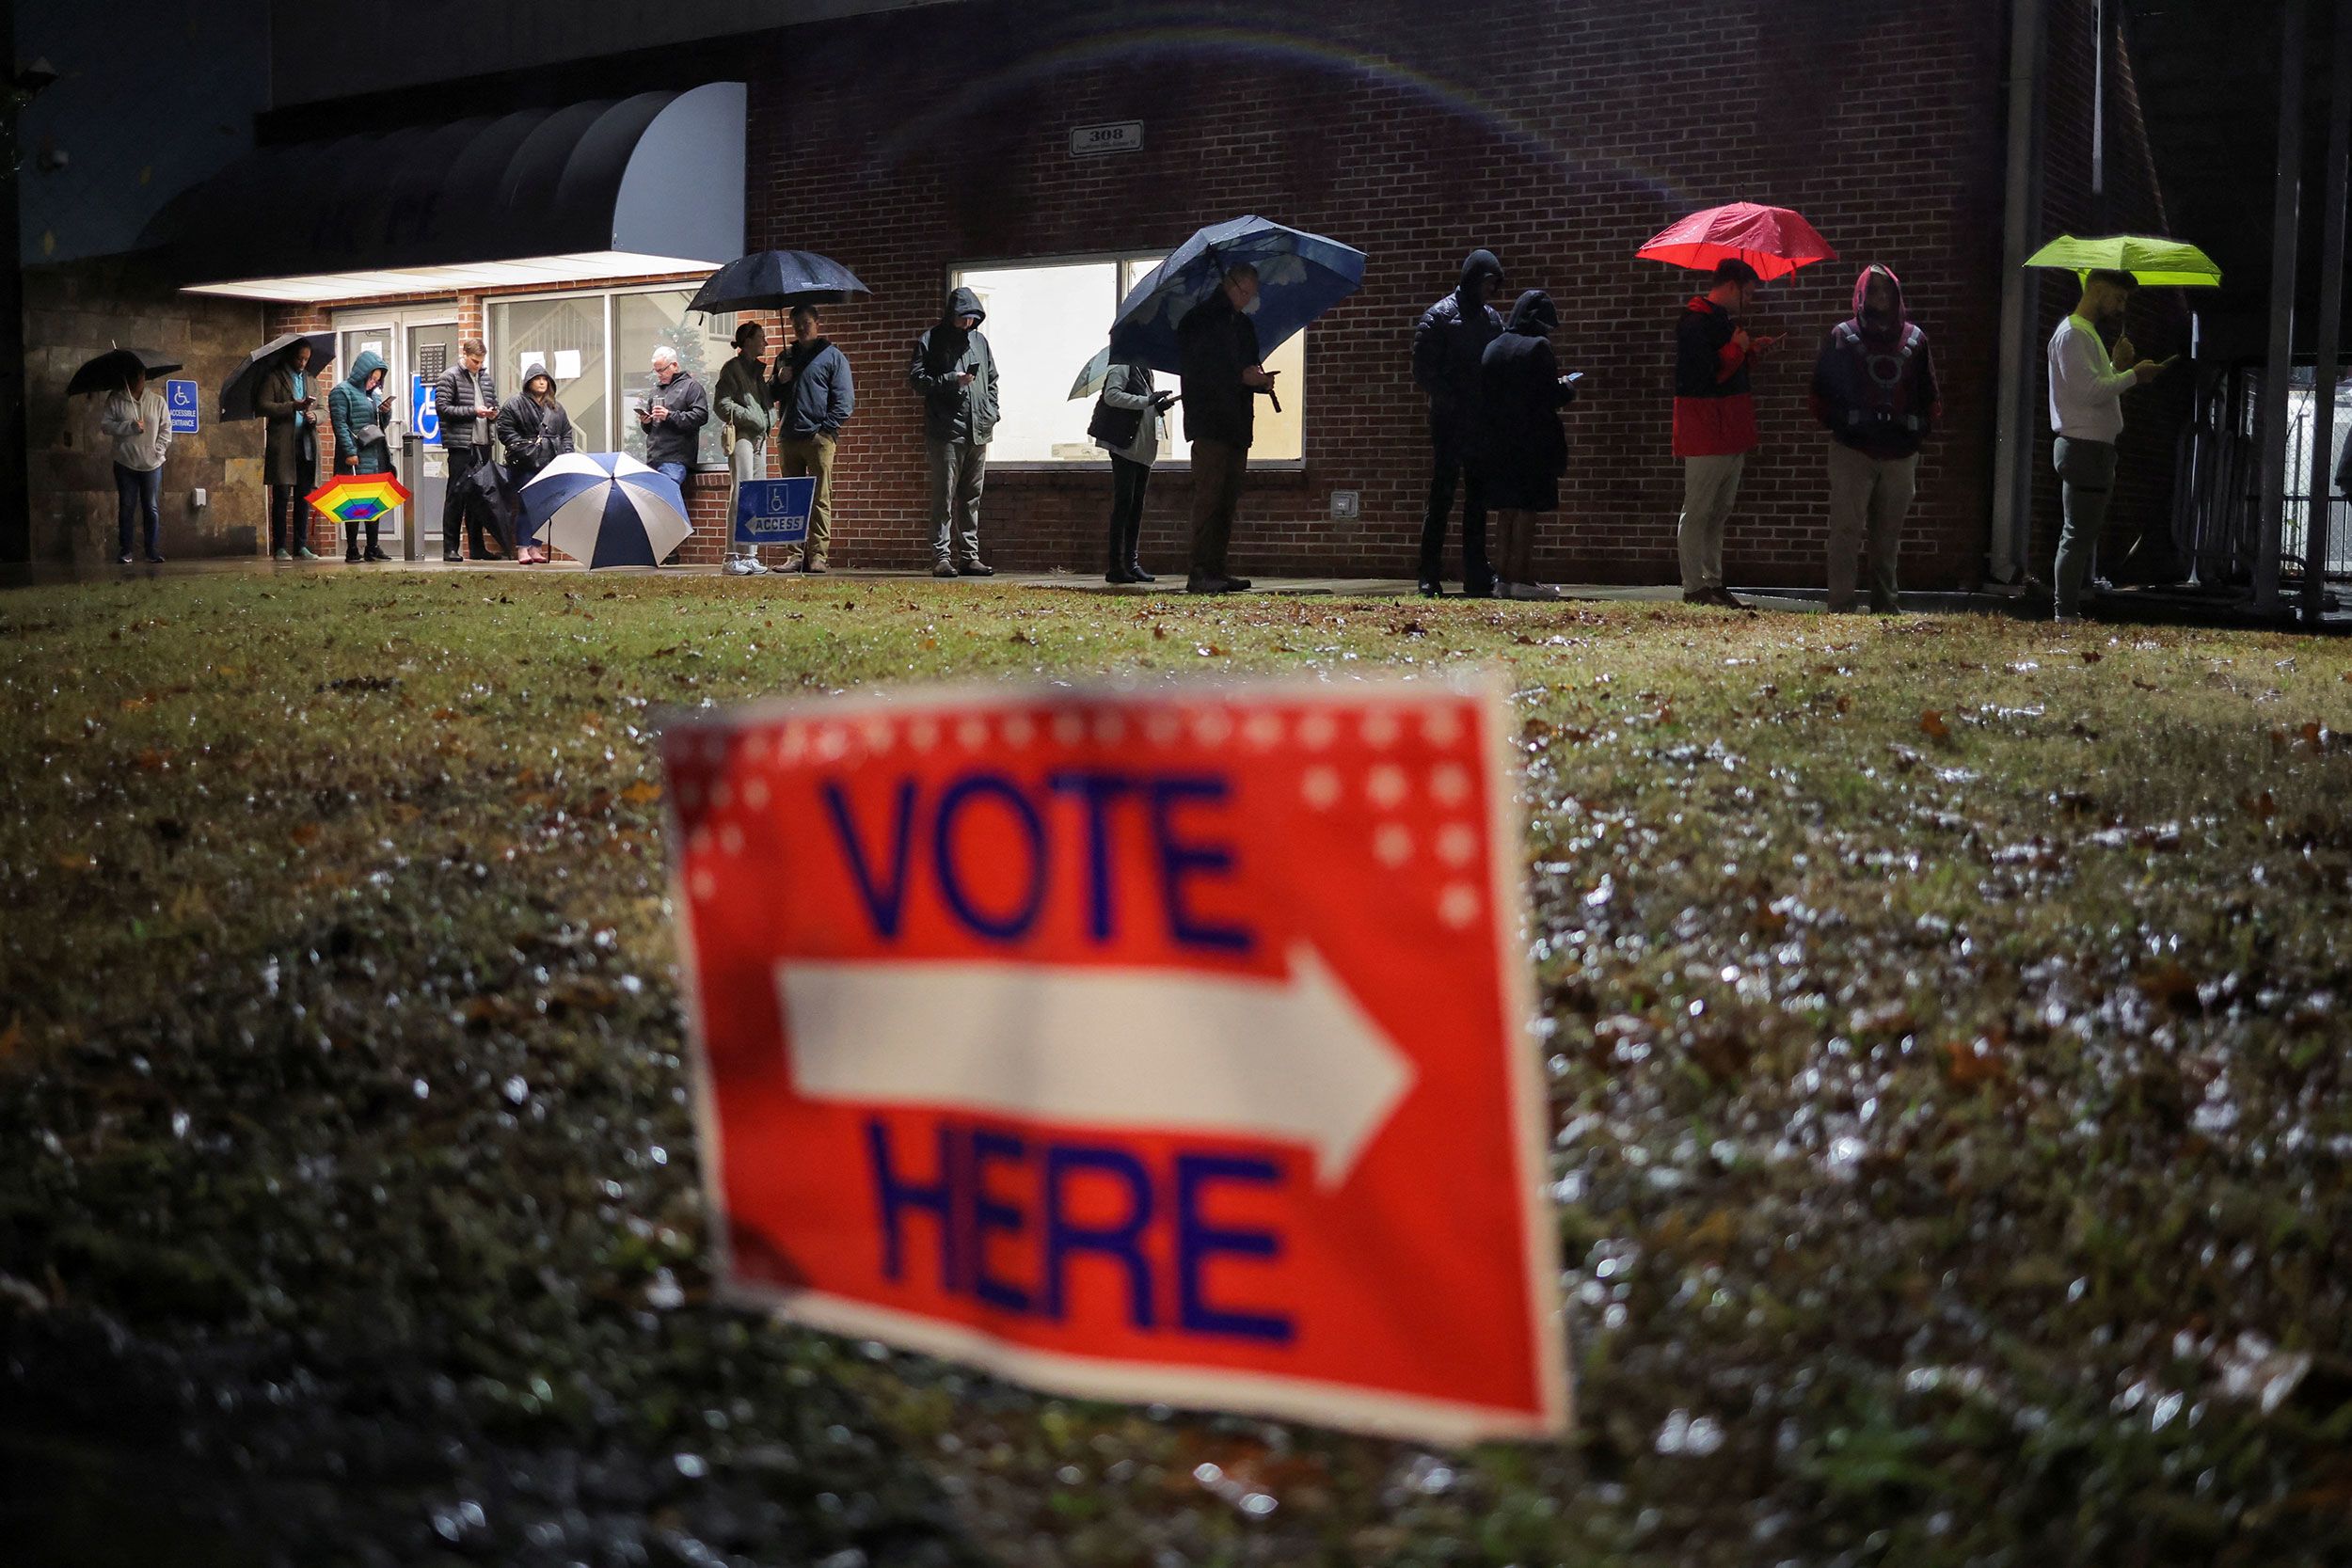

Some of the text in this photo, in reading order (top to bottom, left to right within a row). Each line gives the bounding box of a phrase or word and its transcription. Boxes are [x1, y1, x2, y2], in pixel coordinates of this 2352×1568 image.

[1089, 129, 1123, 141] 308
[755, 517, 801, 531] ACCESS
[820, 771, 1255, 955] VOTE
[863, 1114, 1296, 1342] HERE
